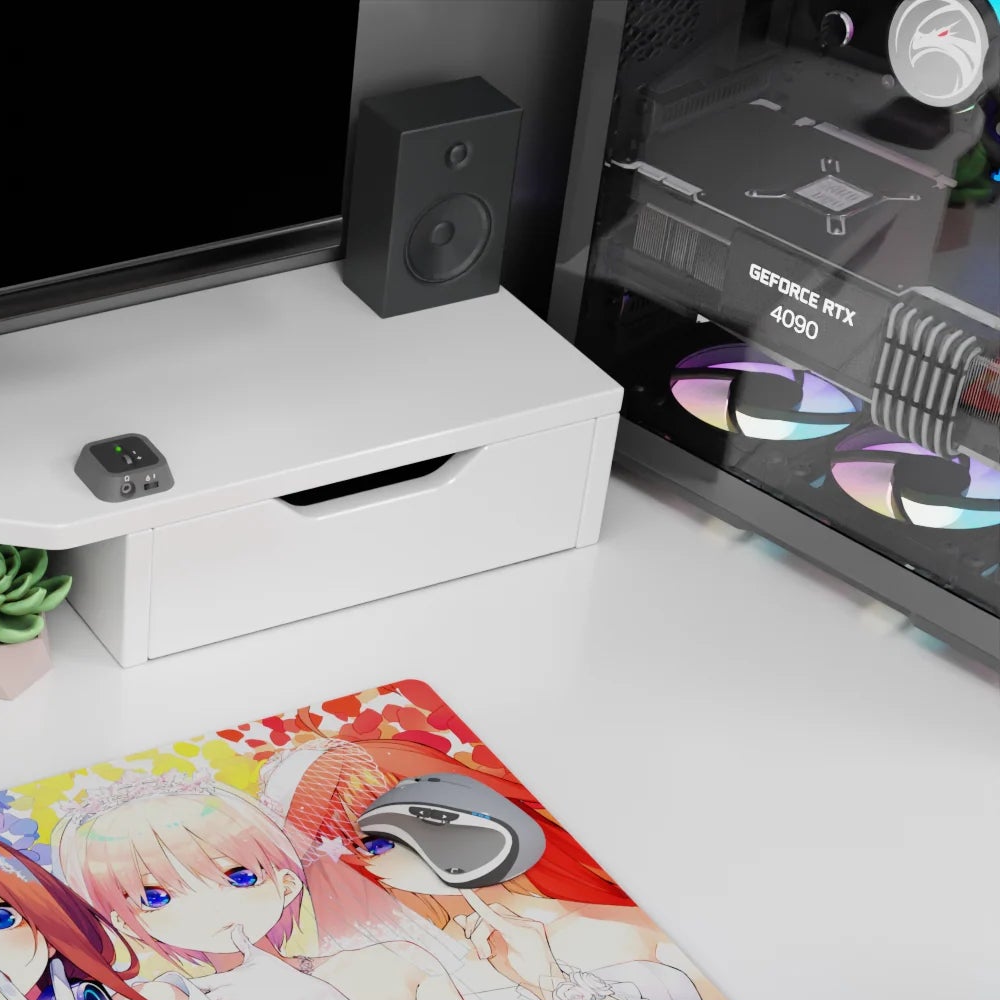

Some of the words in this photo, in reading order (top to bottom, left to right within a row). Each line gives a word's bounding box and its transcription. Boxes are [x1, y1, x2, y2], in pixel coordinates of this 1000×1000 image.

[749, 263, 821, 310] GEFORCE
[823, 298, 857, 327] RTX
[769, 305, 819, 340] 4090
